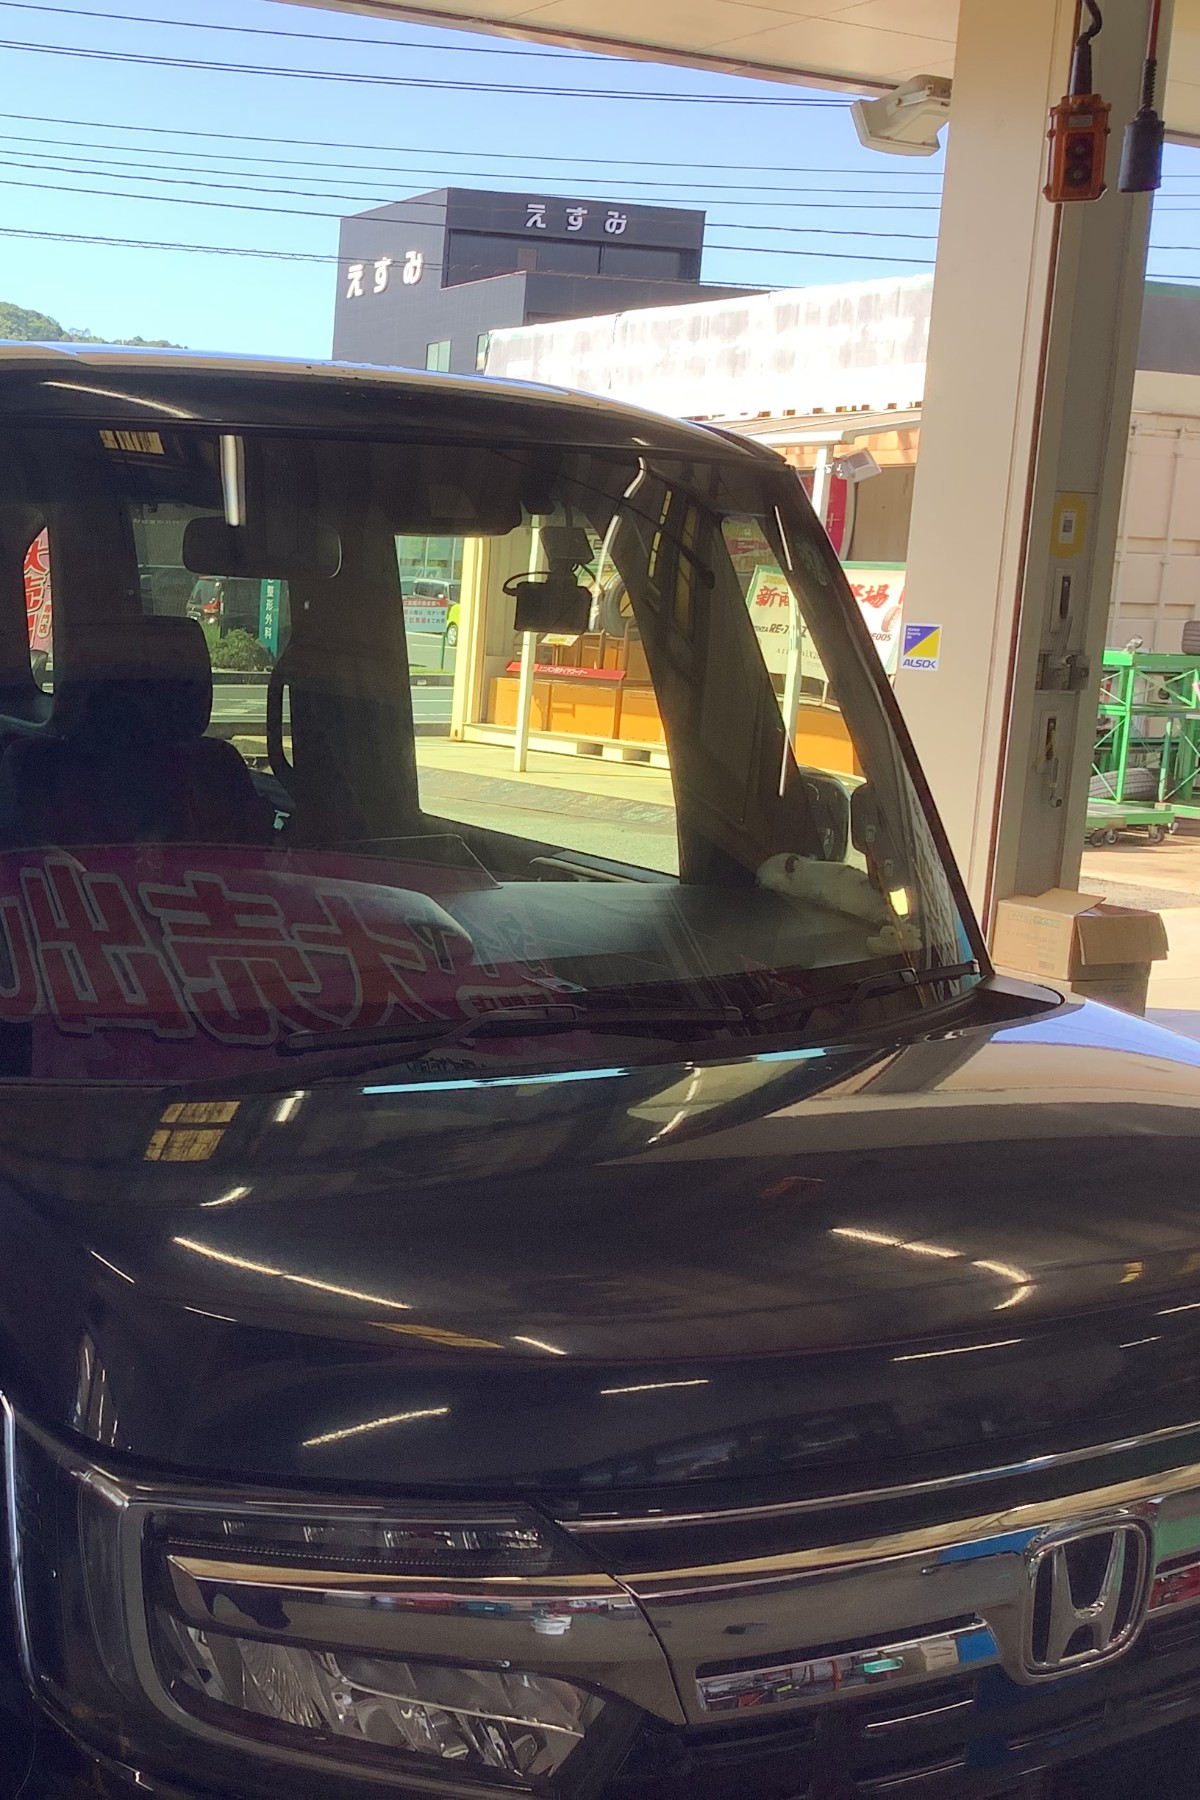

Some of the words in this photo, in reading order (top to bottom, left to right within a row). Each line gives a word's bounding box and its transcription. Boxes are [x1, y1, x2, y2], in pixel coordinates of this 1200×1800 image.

[525, 203, 628, 235] えすみ
[346, 250, 425, 299] えすみ
[903, 658, 936, 669] ALSOK
